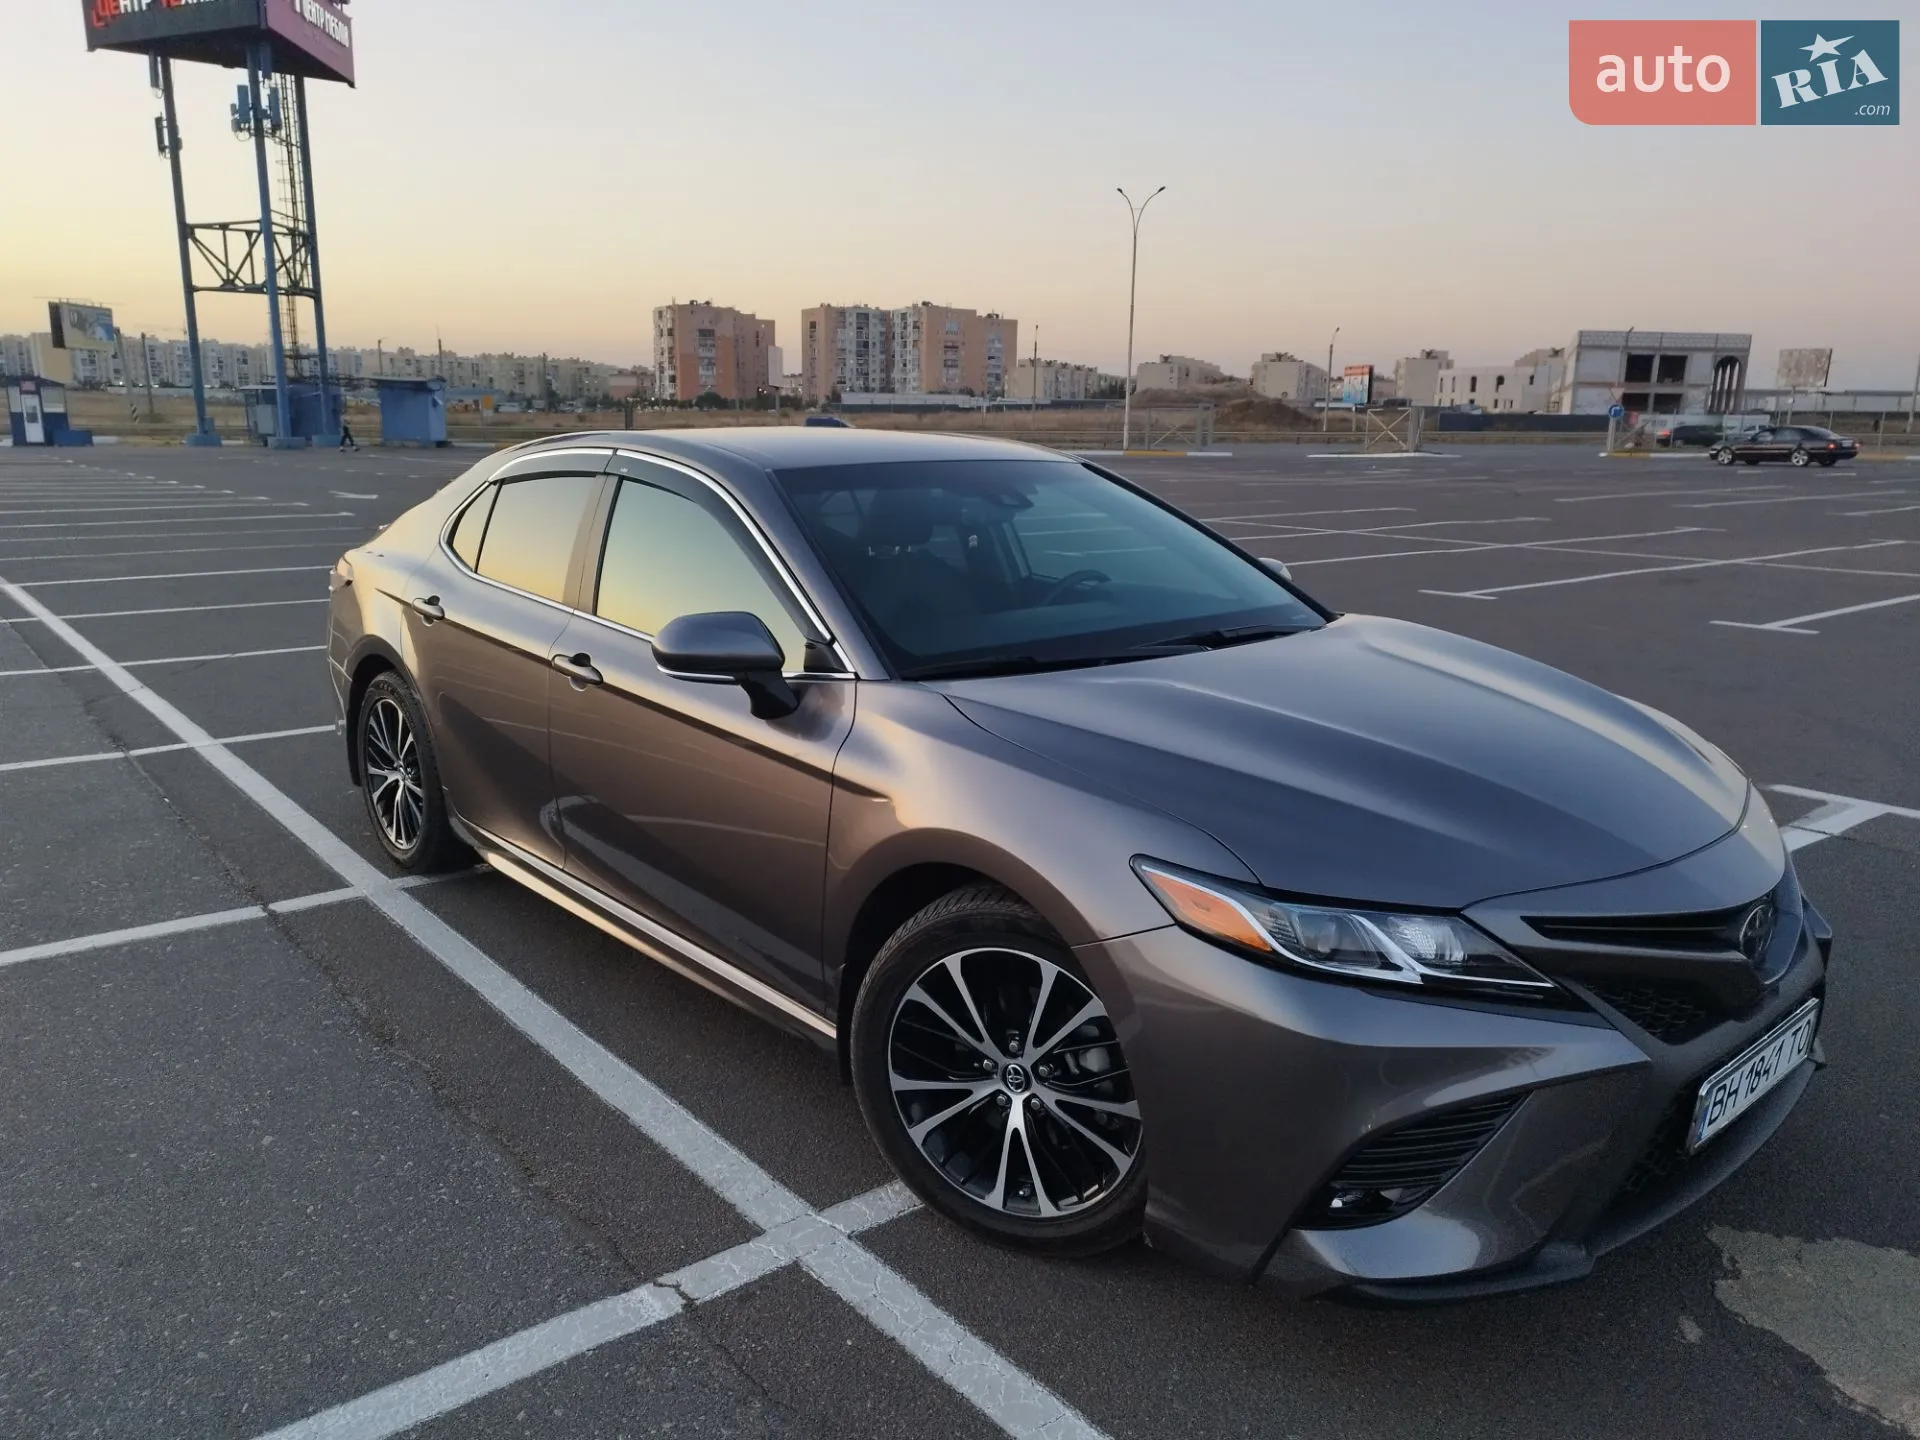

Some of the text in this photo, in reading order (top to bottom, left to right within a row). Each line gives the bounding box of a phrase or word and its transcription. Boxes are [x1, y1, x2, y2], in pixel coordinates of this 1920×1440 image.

[1707, 1018, 1811, 1127] BH 1841 TO
